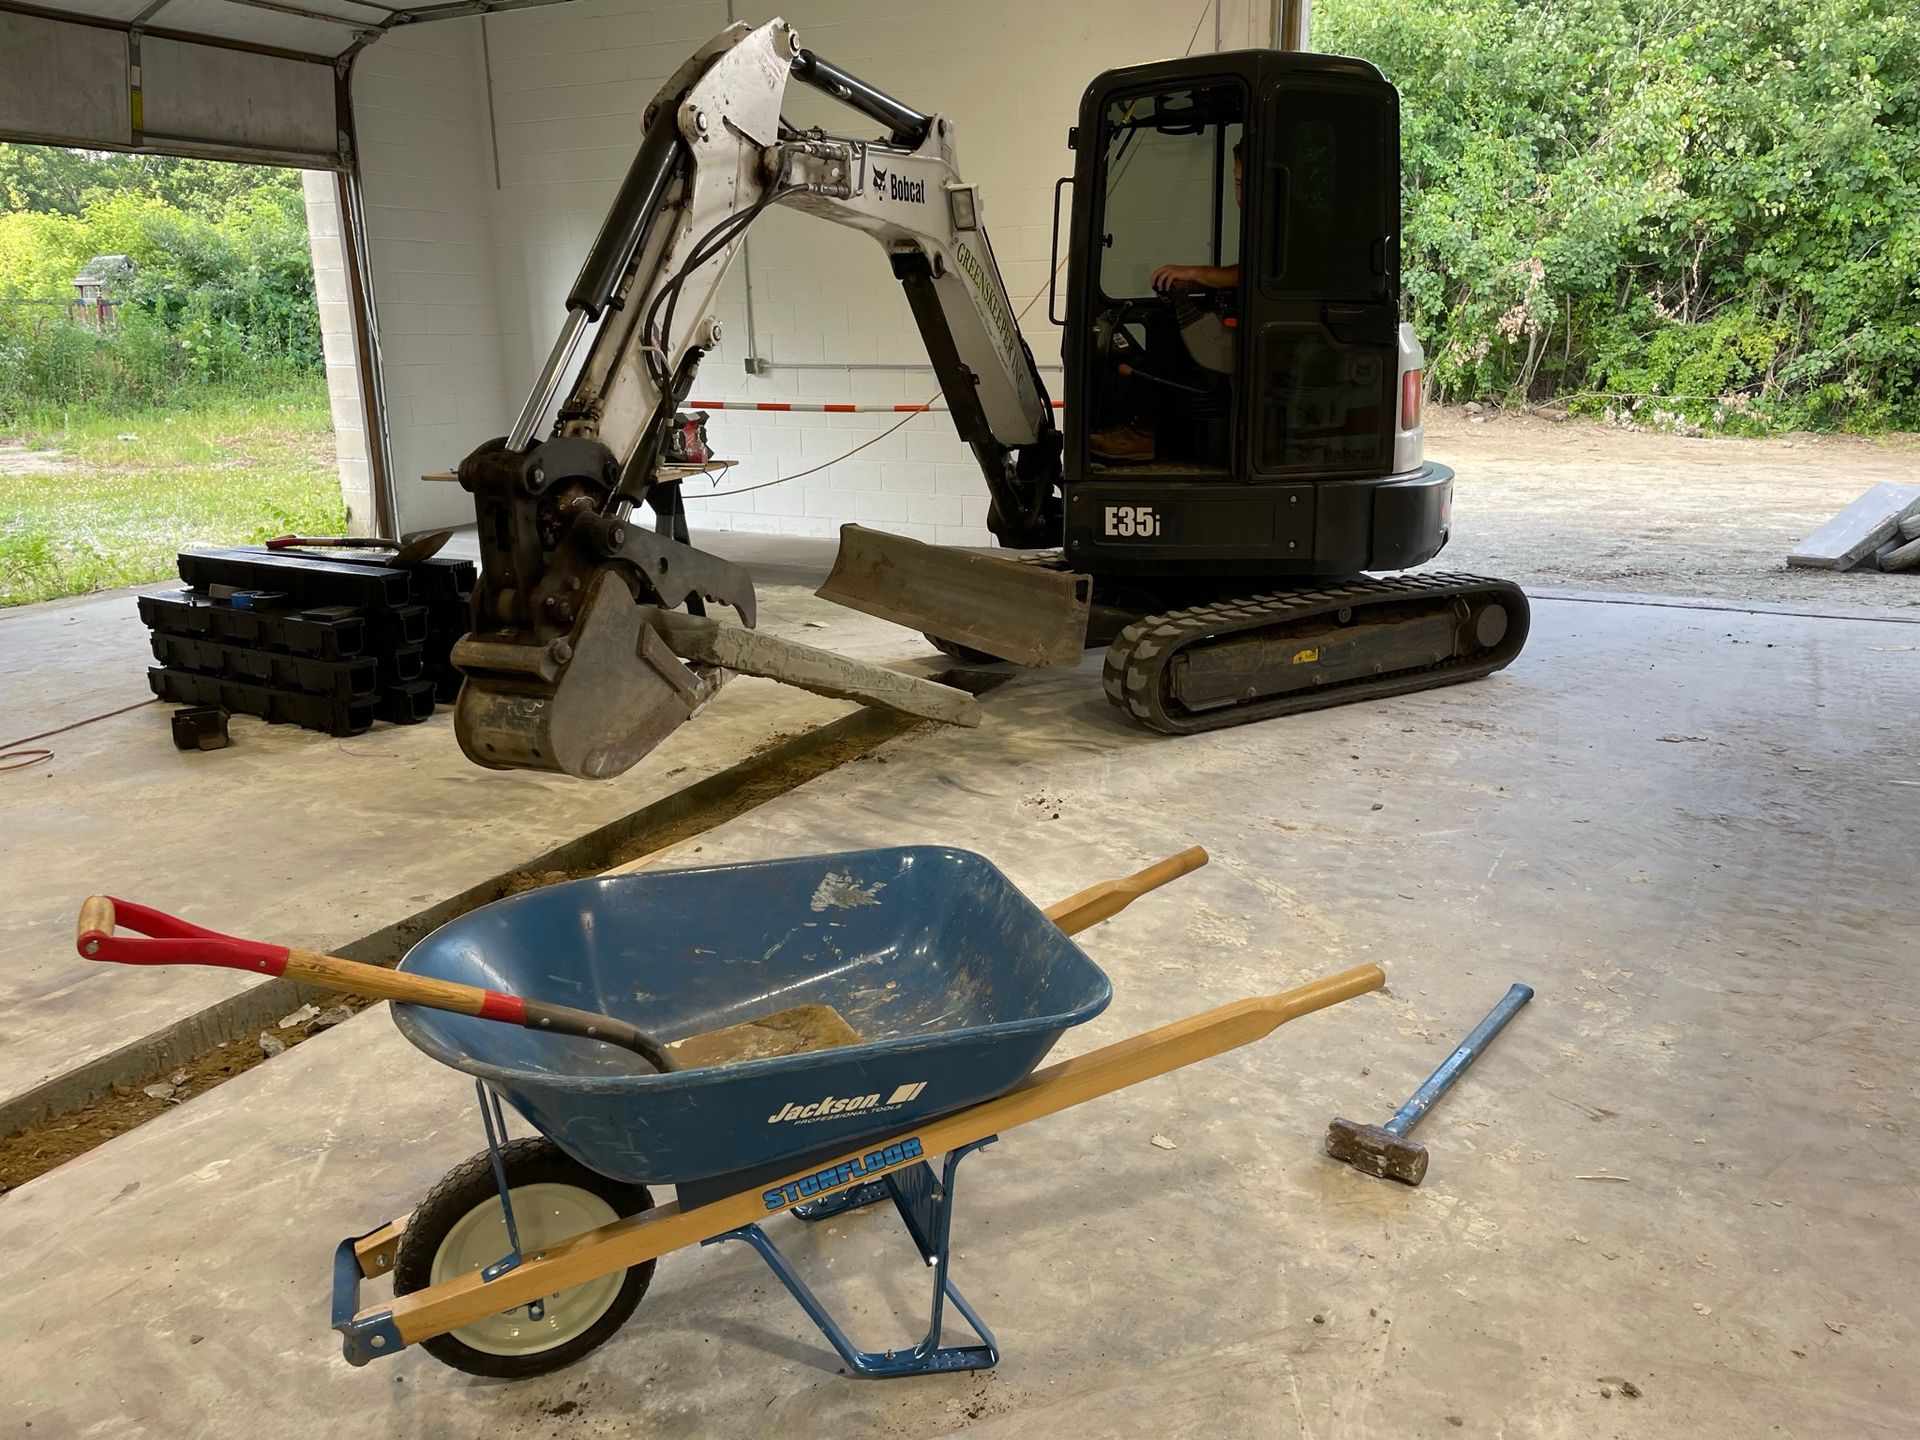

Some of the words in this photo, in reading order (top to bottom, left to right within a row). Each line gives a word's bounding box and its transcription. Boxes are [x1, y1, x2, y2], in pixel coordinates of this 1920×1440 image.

[890, 173, 925, 204] Bobcat
[956, 242, 1013, 358] GREENSKEEPER
[1104, 505, 1160, 537] E35i
[767, 1093, 881, 1124] Jackson
[794, 1109, 870, 1126] PROFESSIONAL
[871, 1103, 903, 1114] TOOLS
[762, 1136, 923, 1210] STONFLOOR
